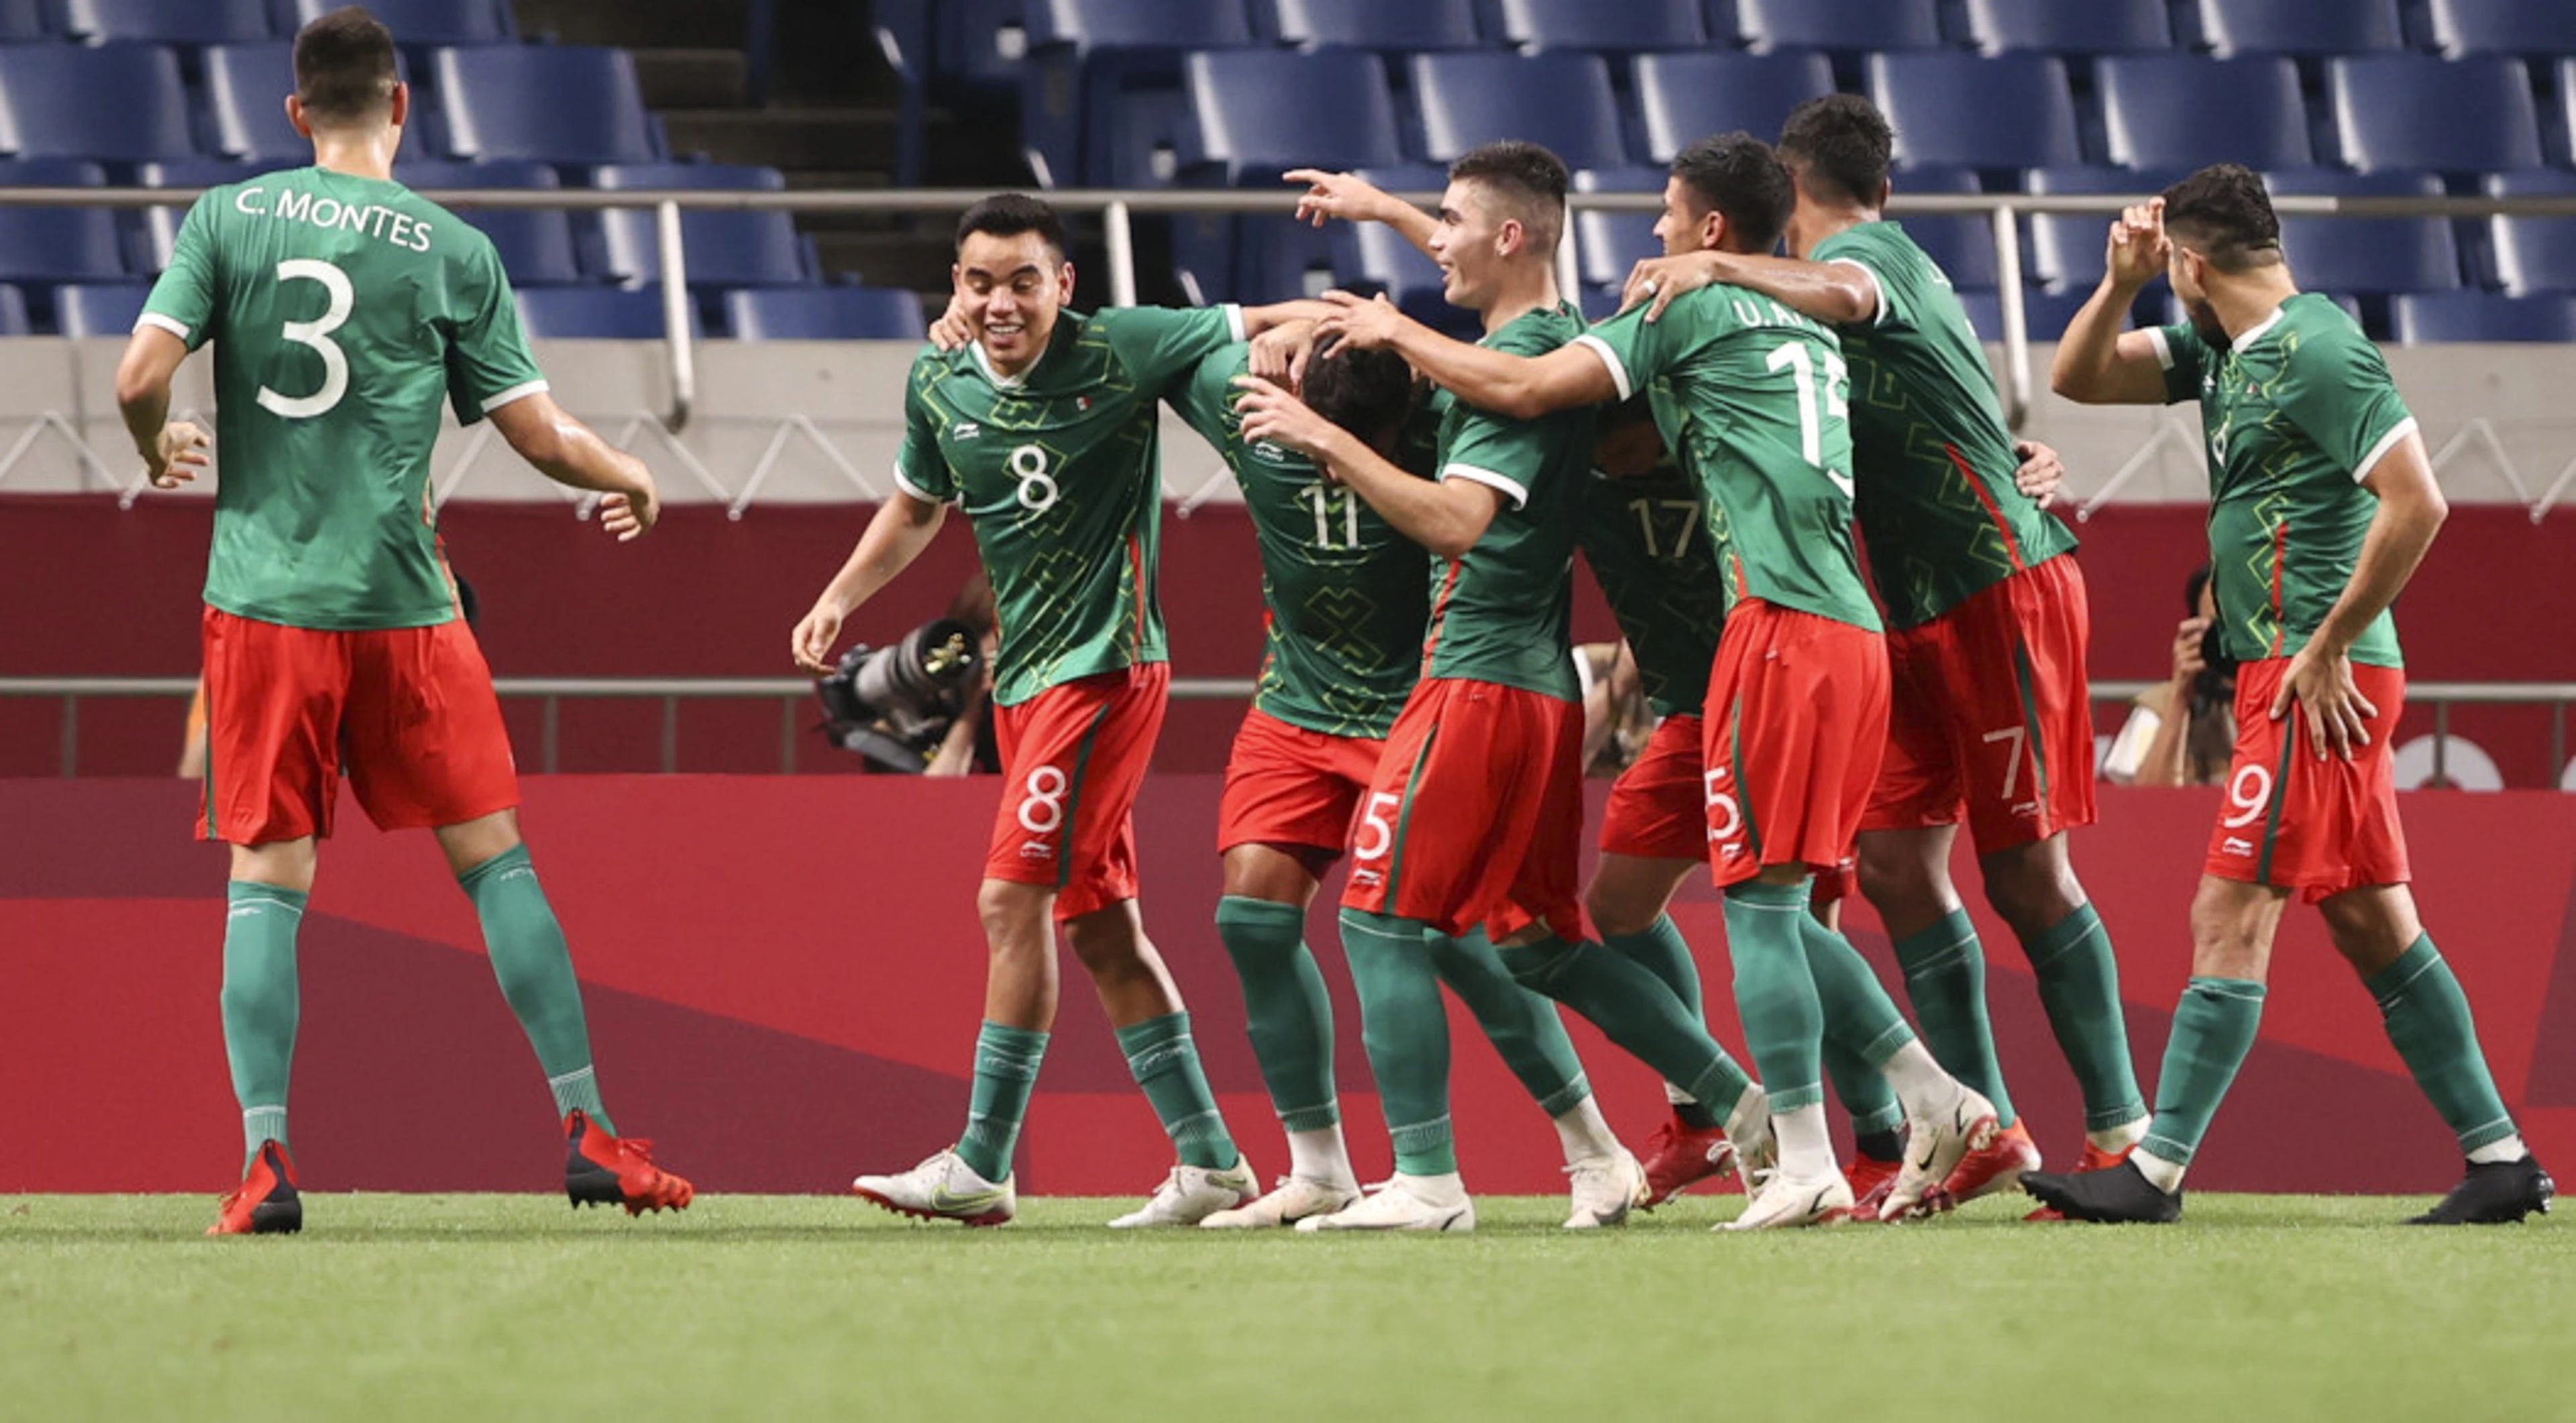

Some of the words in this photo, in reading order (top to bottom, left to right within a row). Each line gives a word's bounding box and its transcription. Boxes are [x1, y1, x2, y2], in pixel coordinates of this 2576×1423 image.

[235, 187, 265, 215] C.
[275, 189, 433, 253] MONTES
[256, 258, 355, 419] 3
[1012, 444, 1059, 509] 8
[1301, 485, 1358, 549] 11
[1629, 498, 1699, 558] 17
[1982, 725, 2025, 800] 7
[2224, 763, 2271, 828] 9
[1018, 765, 1065, 833] 8
[1354, 792, 1399, 860] 5
